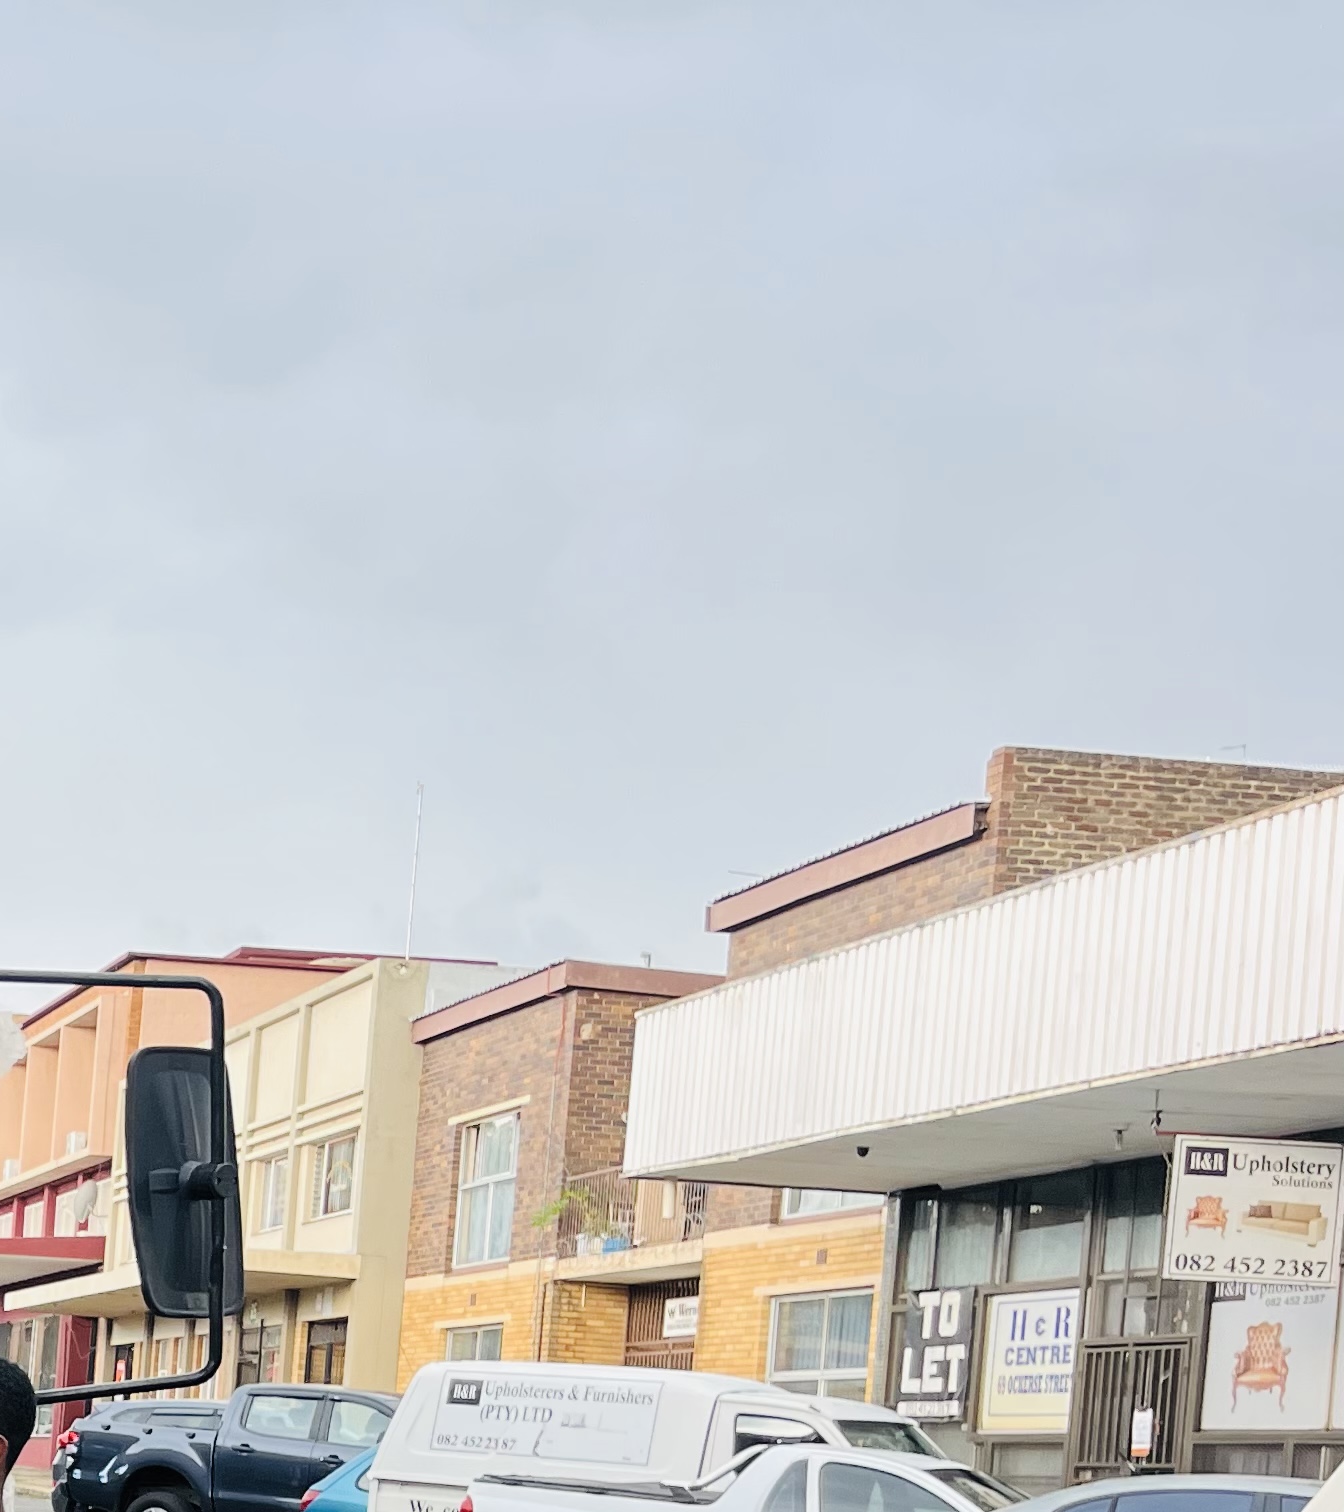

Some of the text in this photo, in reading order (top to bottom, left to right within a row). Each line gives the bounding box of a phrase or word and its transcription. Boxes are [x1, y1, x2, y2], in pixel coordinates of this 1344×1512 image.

[1190, 1151, 1337, 1180] H&R Upholstery
[1272, 1175, 1333, 1189] Solutions
[1175, 1253, 1328, 1278] 082 452 2387
[918, 1290, 961, 1340] TO
[1055, 1306, 1070, 1338] R
[1005, 1344, 1072, 1366] CENTRE
[900, 1344, 965, 1394] LET
[485, 1381, 564, 1400] Upholsterers
[568, 1385, 578, 1400] &
[584, 1386, 654, 1405] Furnishers
[1044, 1373, 1073, 1393] STREE
[480, 1404, 553, 1423] (PTY) LTD
